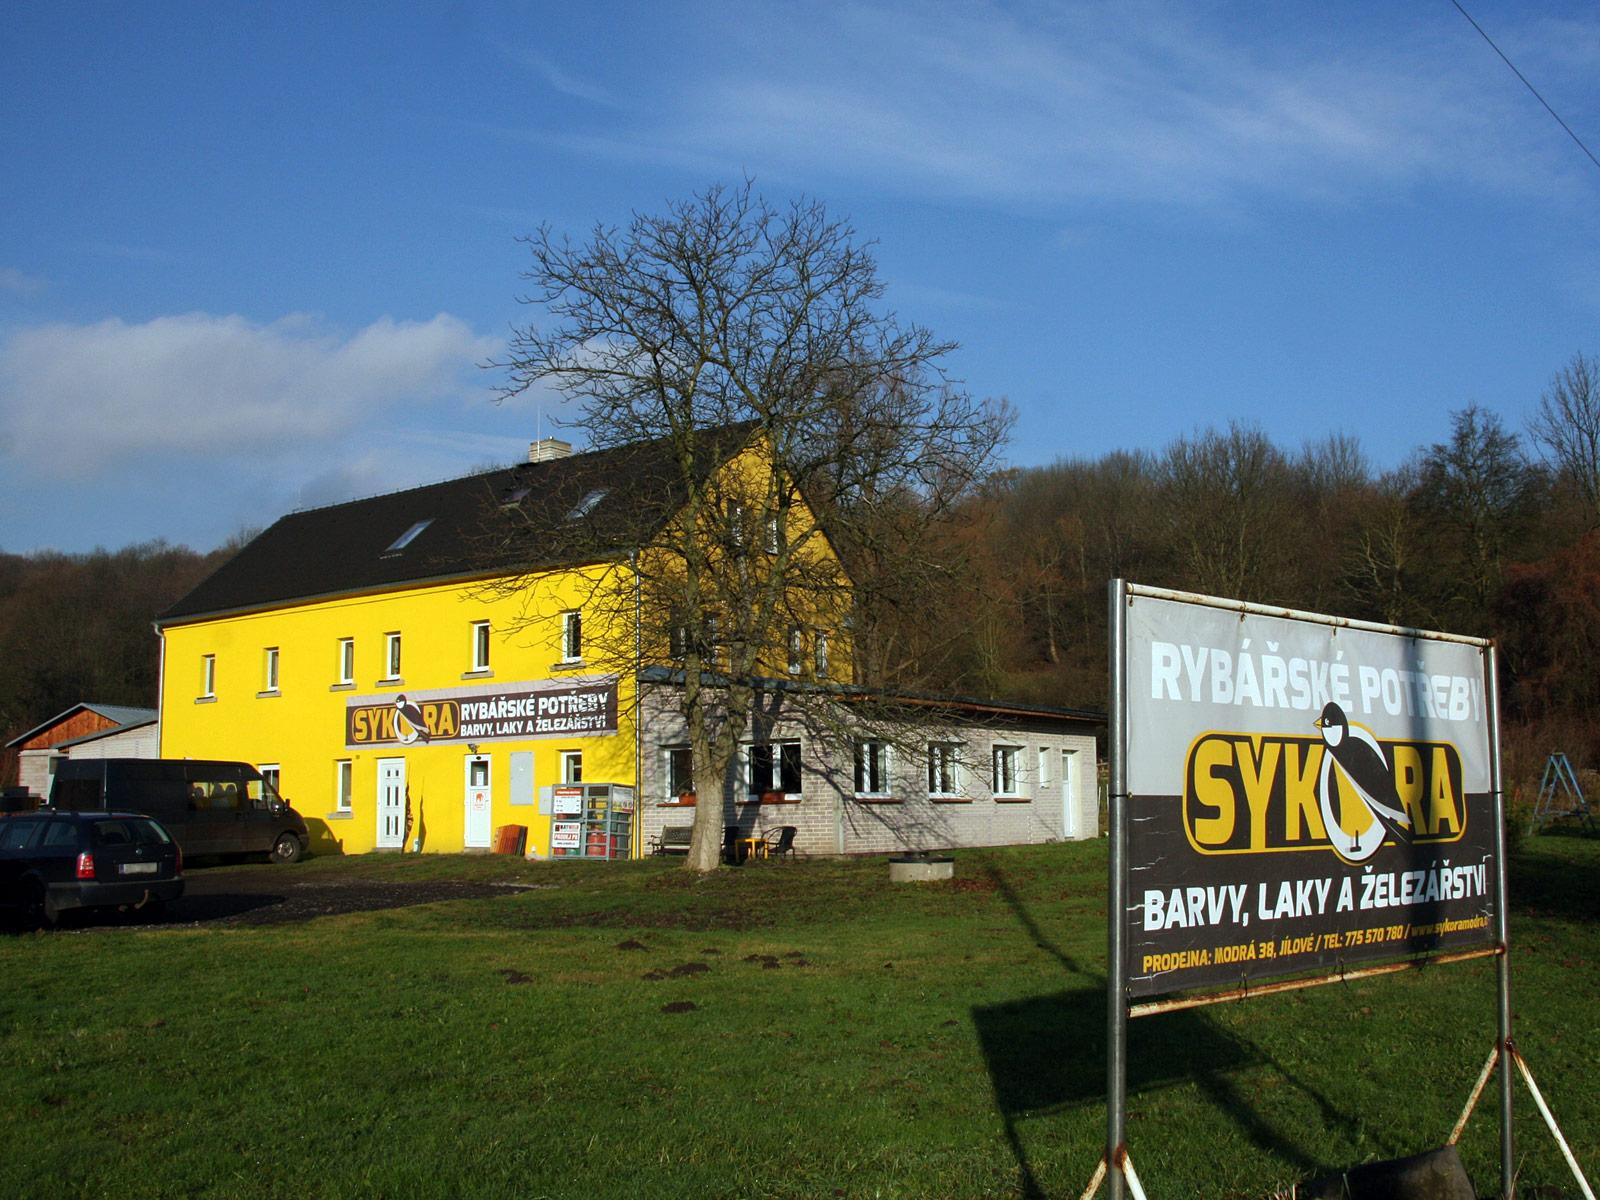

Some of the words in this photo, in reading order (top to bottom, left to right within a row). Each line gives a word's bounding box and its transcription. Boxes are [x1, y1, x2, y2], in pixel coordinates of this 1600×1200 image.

[1151, 639, 1353, 713] RYBÁŘSKÉ
[1359, 660, 1481, 722] POTŘEBY
[460, 694, 536, 721] RYBÁŘSKÉ
[538, 690, 609, 715] POTŘEBY
[460, 722, 495, 737] BARVY,
[496, 720, 524, 735] LAKY
[526, 719, 534, 733] A
[535, 712, 607, 732] ŽELEZÁŘSTVÍ
[1143, 883, 1249, 931] BARVY,
[1258, 878, 1331, 921] LAKY
[1336, 876, 1354, 912] A
[1360, 858, 1487, 910] ŽELEZÁŘSTVÍ
[1143, 948, 1212, 973] PRODEJNA:
[1214, 939, 1256, 964] MODRÁ
[1279, 933, 1314, 956] JÍLOVÉ
[1323, 931, 1343, 950] TEL:
[1345, 929, 1363, 947] 775
[1365, 927, 1384, 944] 570
[1386, 924, 1403, 941] 780
